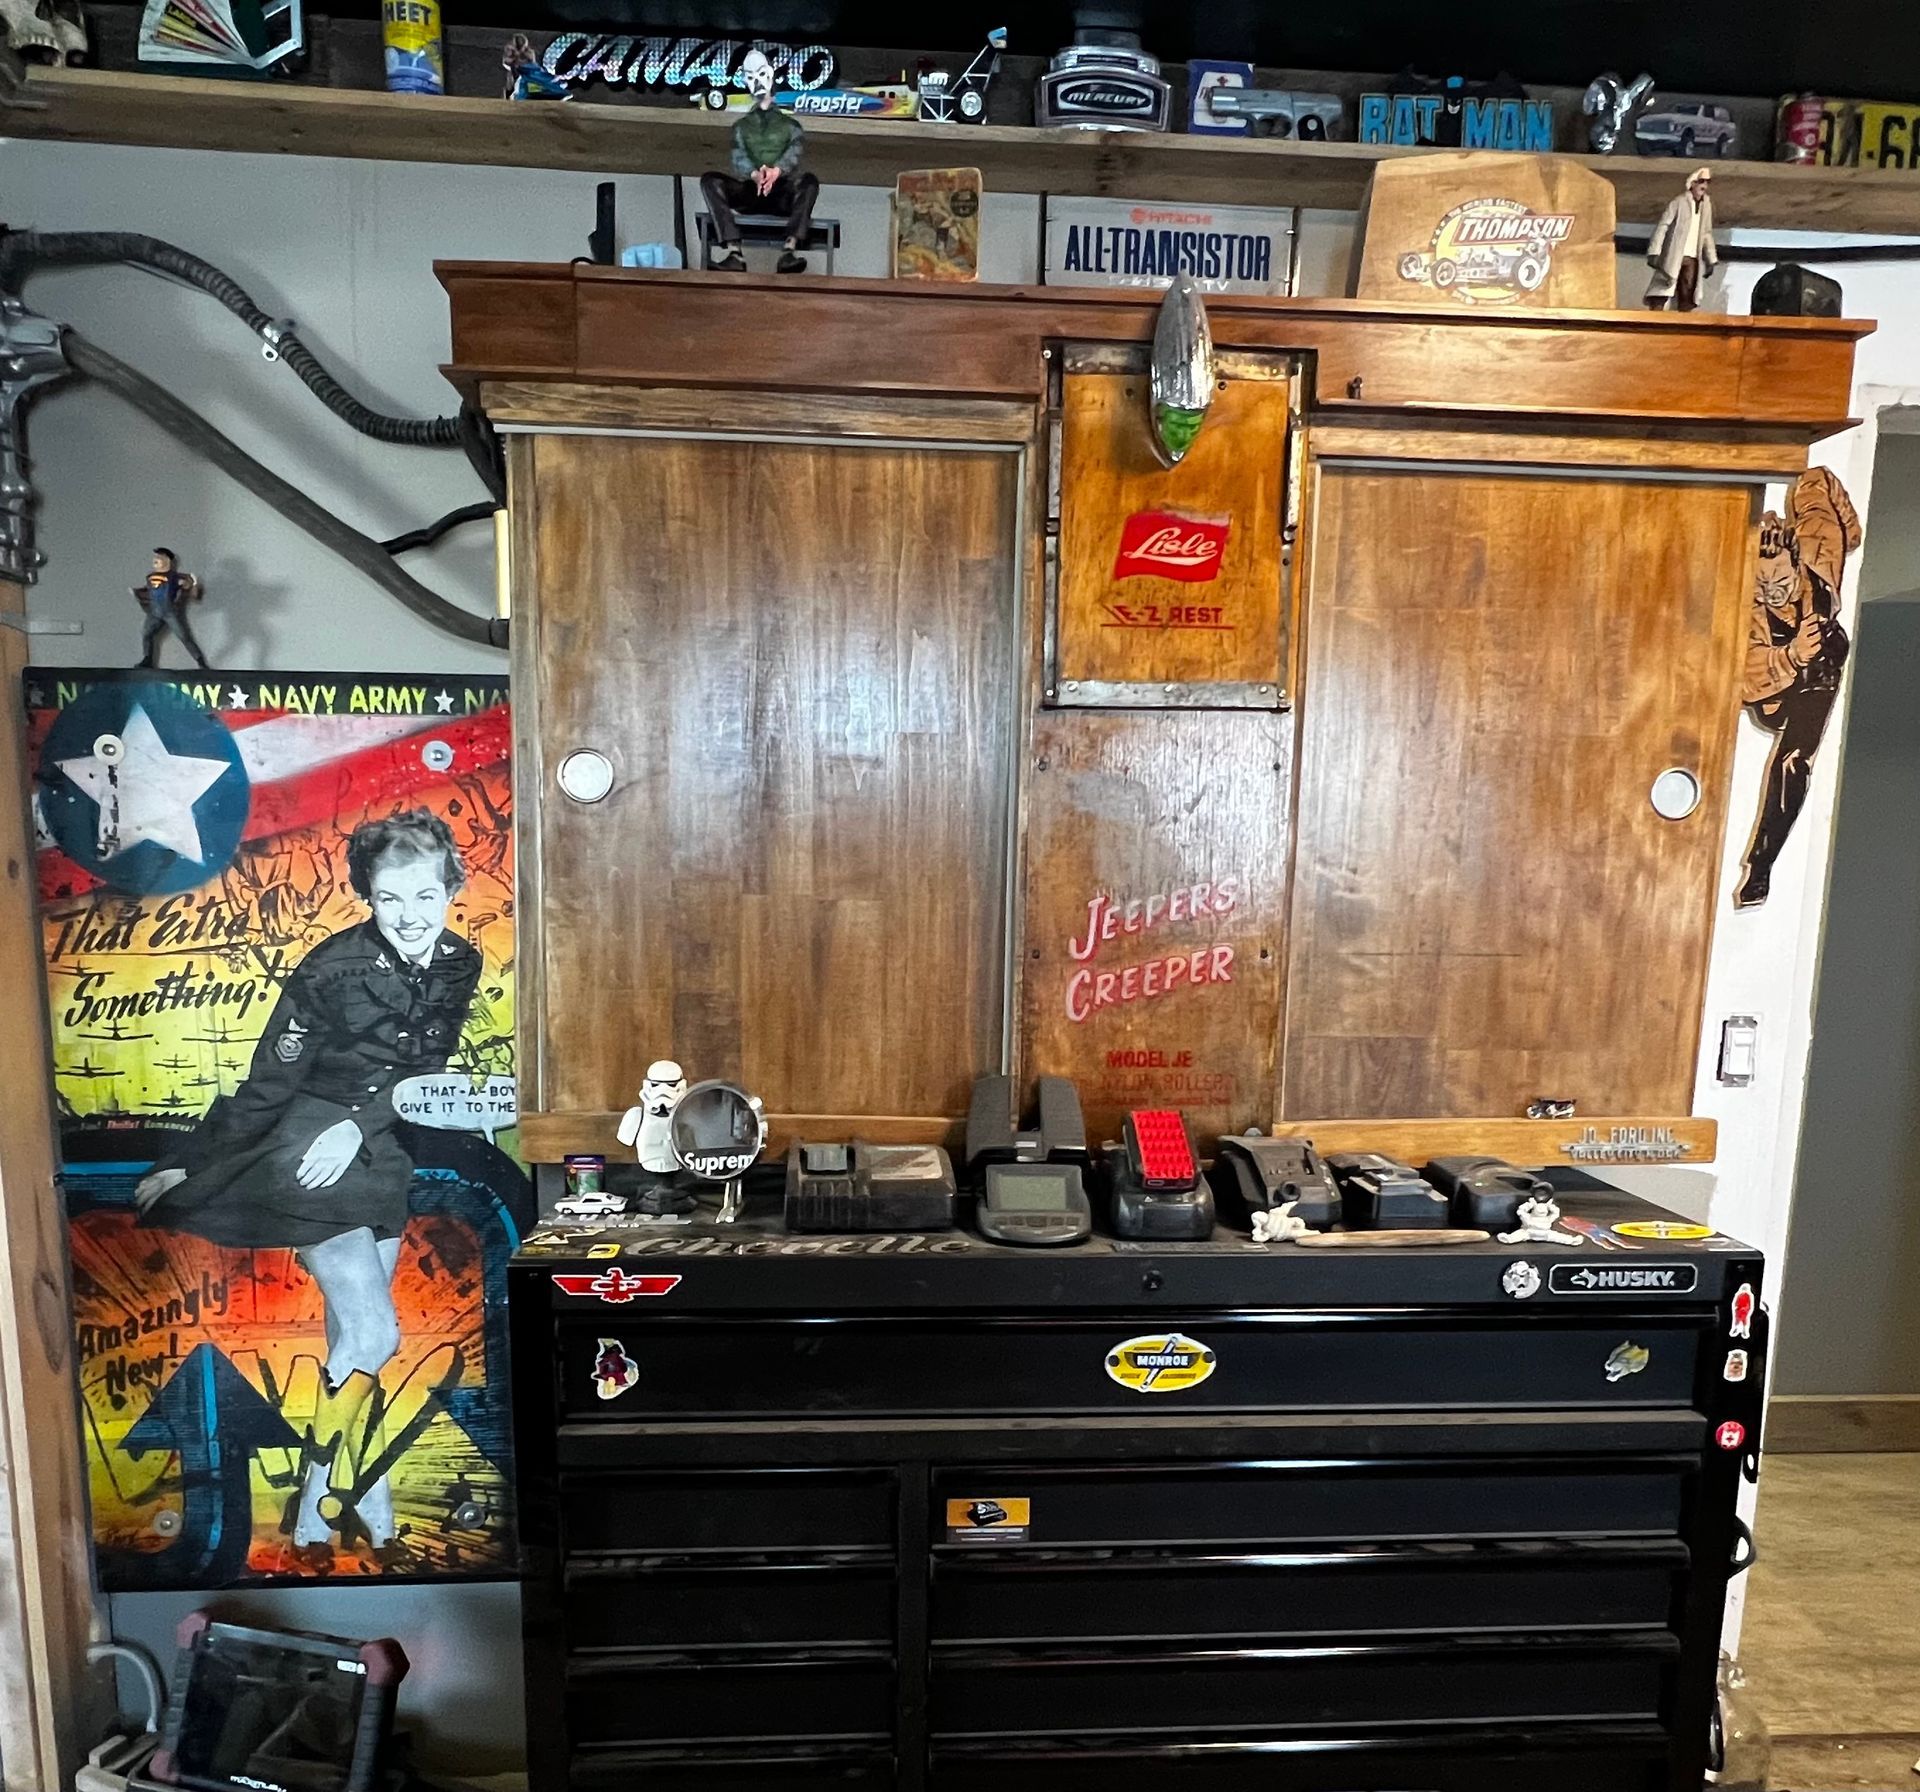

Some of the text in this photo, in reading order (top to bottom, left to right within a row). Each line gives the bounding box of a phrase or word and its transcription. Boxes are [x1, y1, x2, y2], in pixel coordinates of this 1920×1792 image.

[383, 1, 432, 26] HEET
[795, 92, 863, 110] dragster
[1067, 92, 1147, 106] MERCURY
[1458, 218, 1570, 241] THOMPSON
[1064, 225, 1271, 281] ALL-TRANSISTOR
[1122, 526, 1218, 566] Lisle
[1169, 606, 1223, 624] REST
[259, 684, 337, 715] NAVY
[350, 685, 427, 714] ARMY
[48, 894, 250, 962] That Extra
[1067, 876, 1240, 961] JEEPERS
[1065, 943, 1236, 1022] CREEPER
[1106, 1050, 1193, 1068] MODEL JE
[400, 1102, 516, 1113] GIVE IT TO THE
[1599, 1271, 1673, 1287] HUSKY
[79, 1271, 228, 1359] Amazingly
[1136, 1355, 1189, 1366] MONROE
